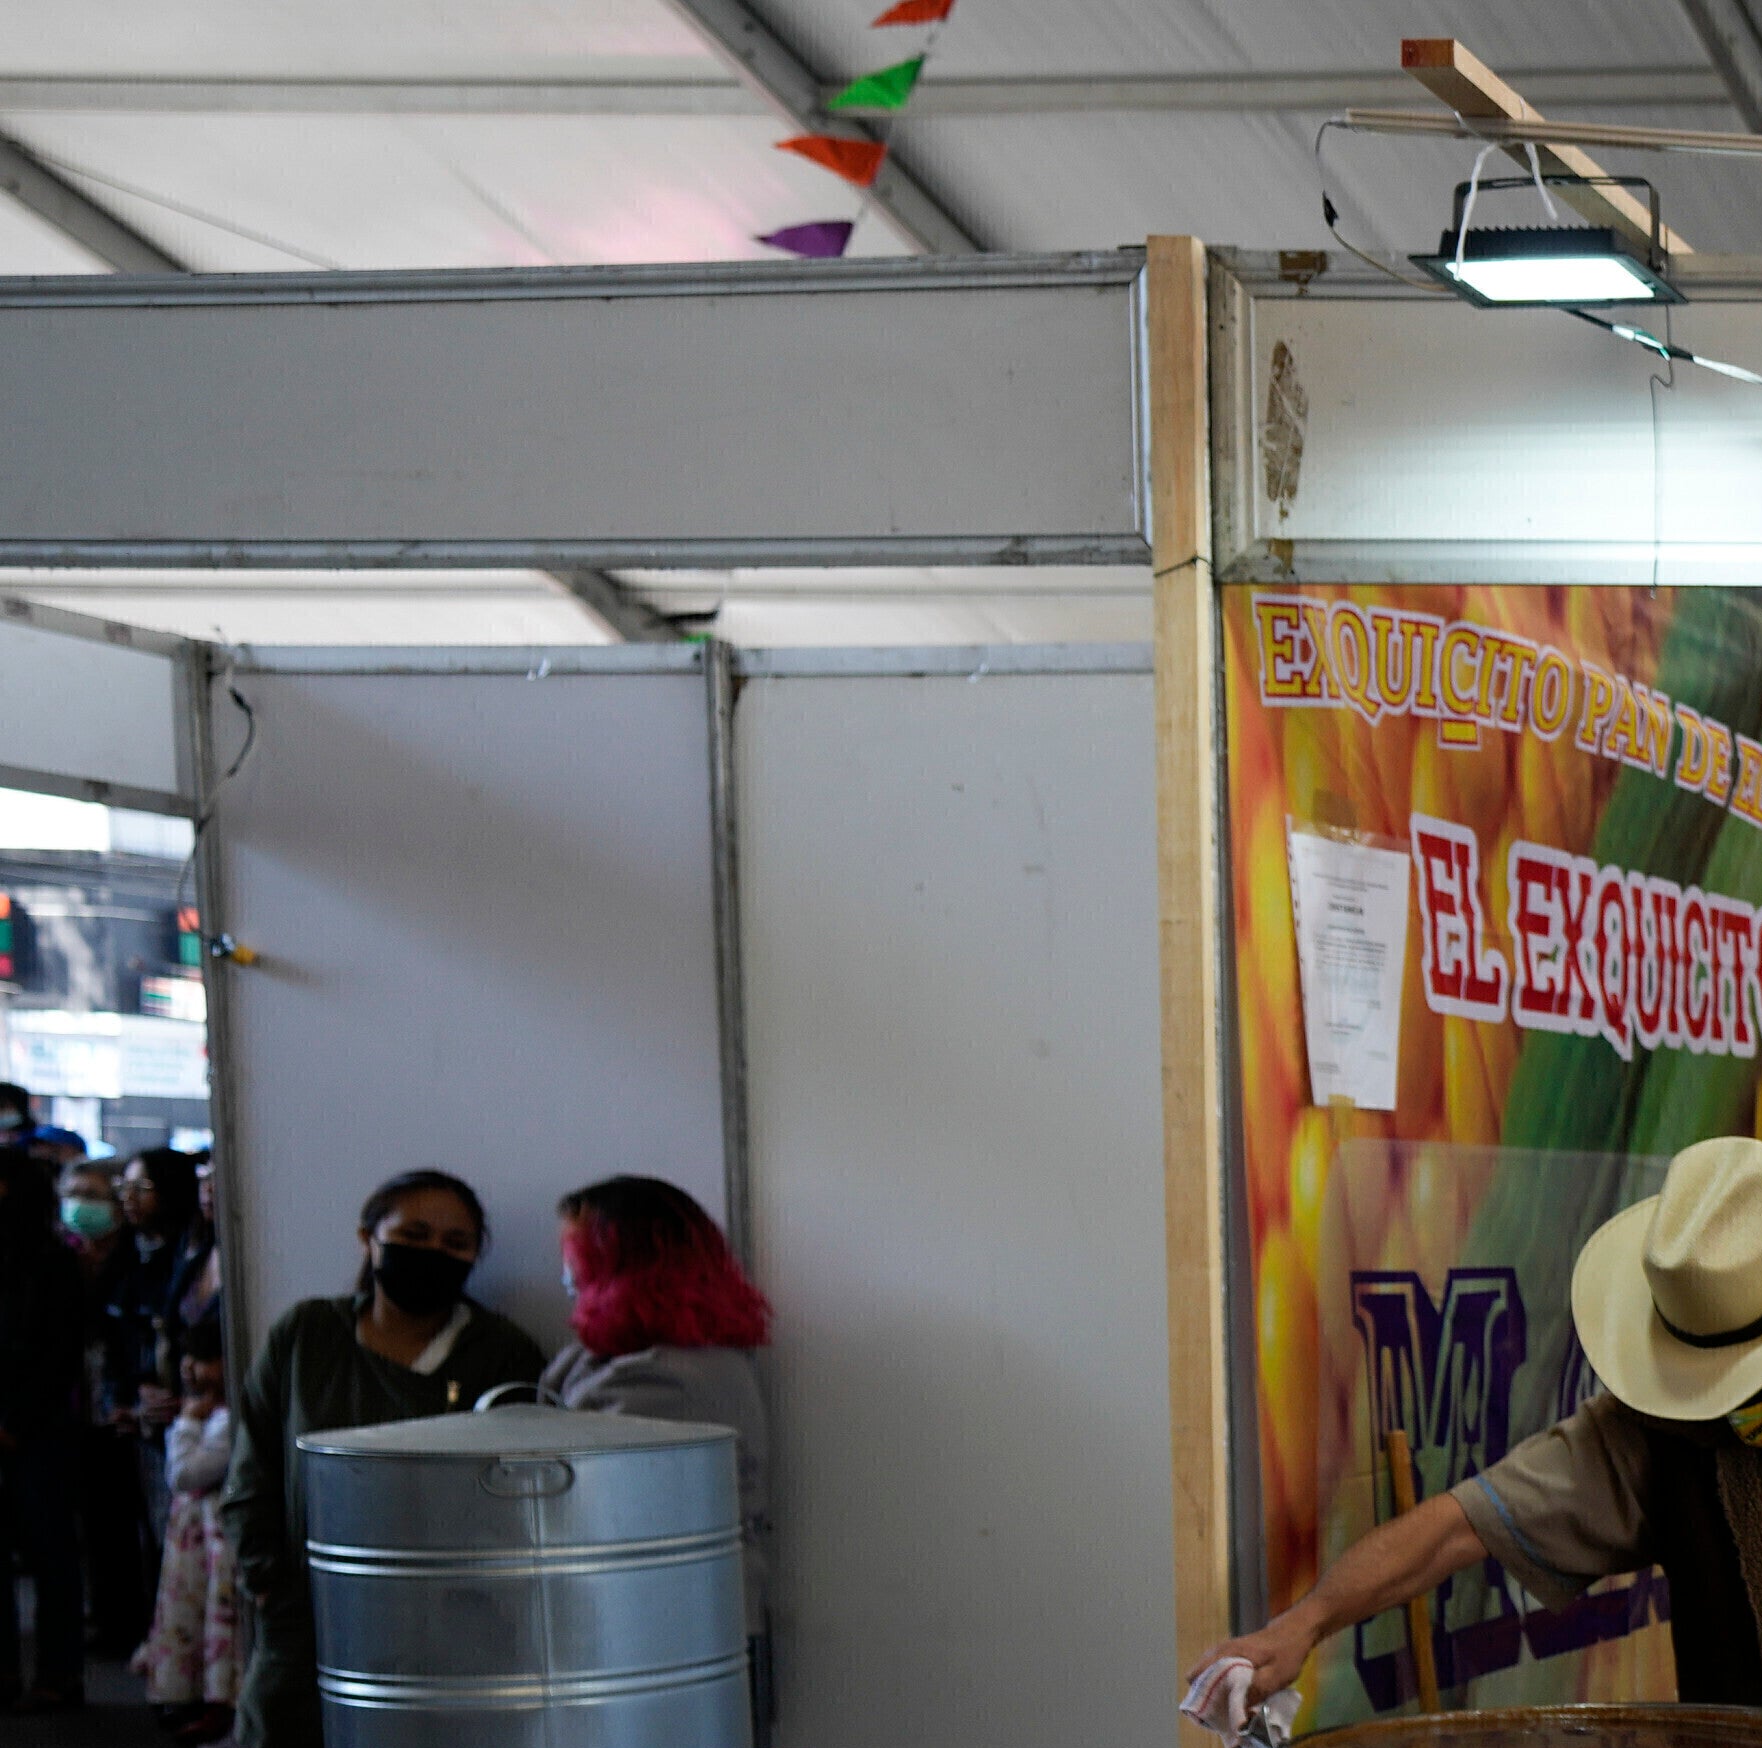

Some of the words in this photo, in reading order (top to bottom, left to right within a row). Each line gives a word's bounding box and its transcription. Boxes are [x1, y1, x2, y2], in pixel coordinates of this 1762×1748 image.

[1580, 664, 1672, 776] PAN
[1677, 706, 1732, 804] DE
[1419, 834, 1499, 1003] EL
